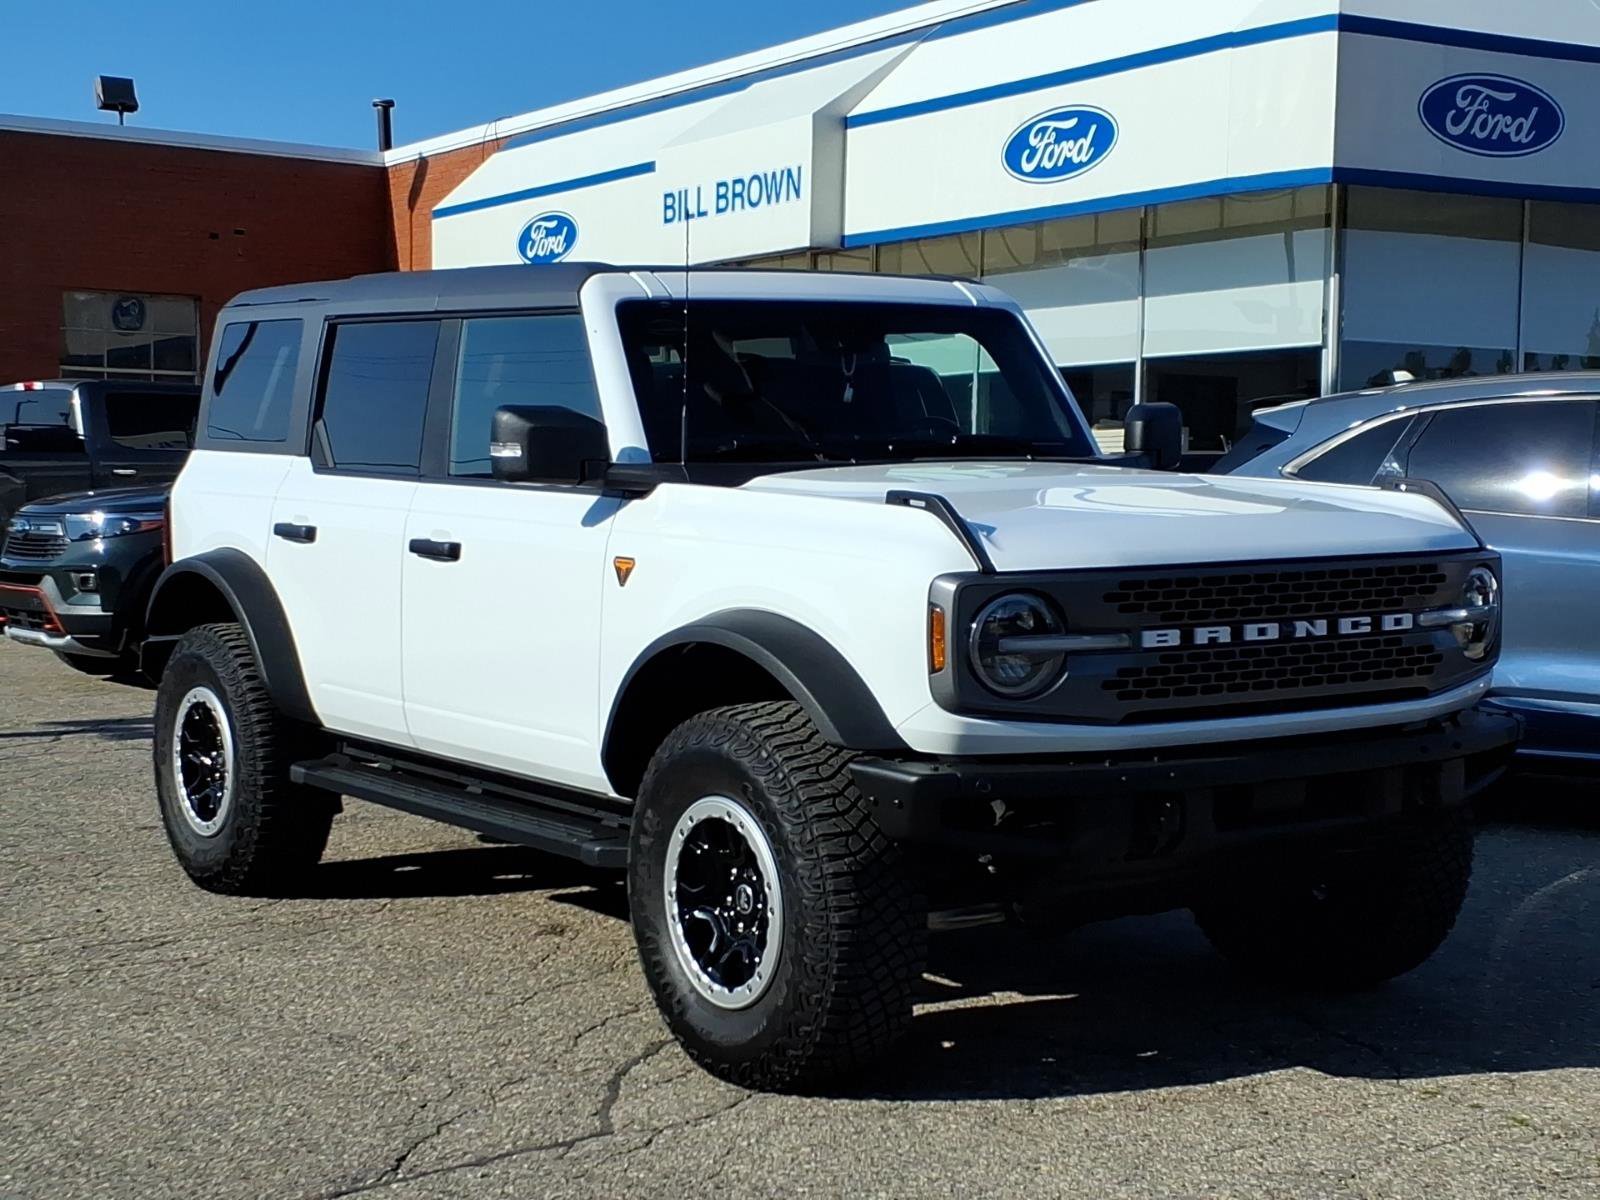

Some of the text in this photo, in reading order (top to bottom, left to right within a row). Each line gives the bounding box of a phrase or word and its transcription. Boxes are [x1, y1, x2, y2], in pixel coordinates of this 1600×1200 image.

[1446, 84, 1538, 144] Ford
[1021, 117, 1097, 172] Ford
[663, 166, 802, 224] BILL BROWN
[528, 220, 568, 257] Ford
[1142, 613, 1413, 648] BRONCO
